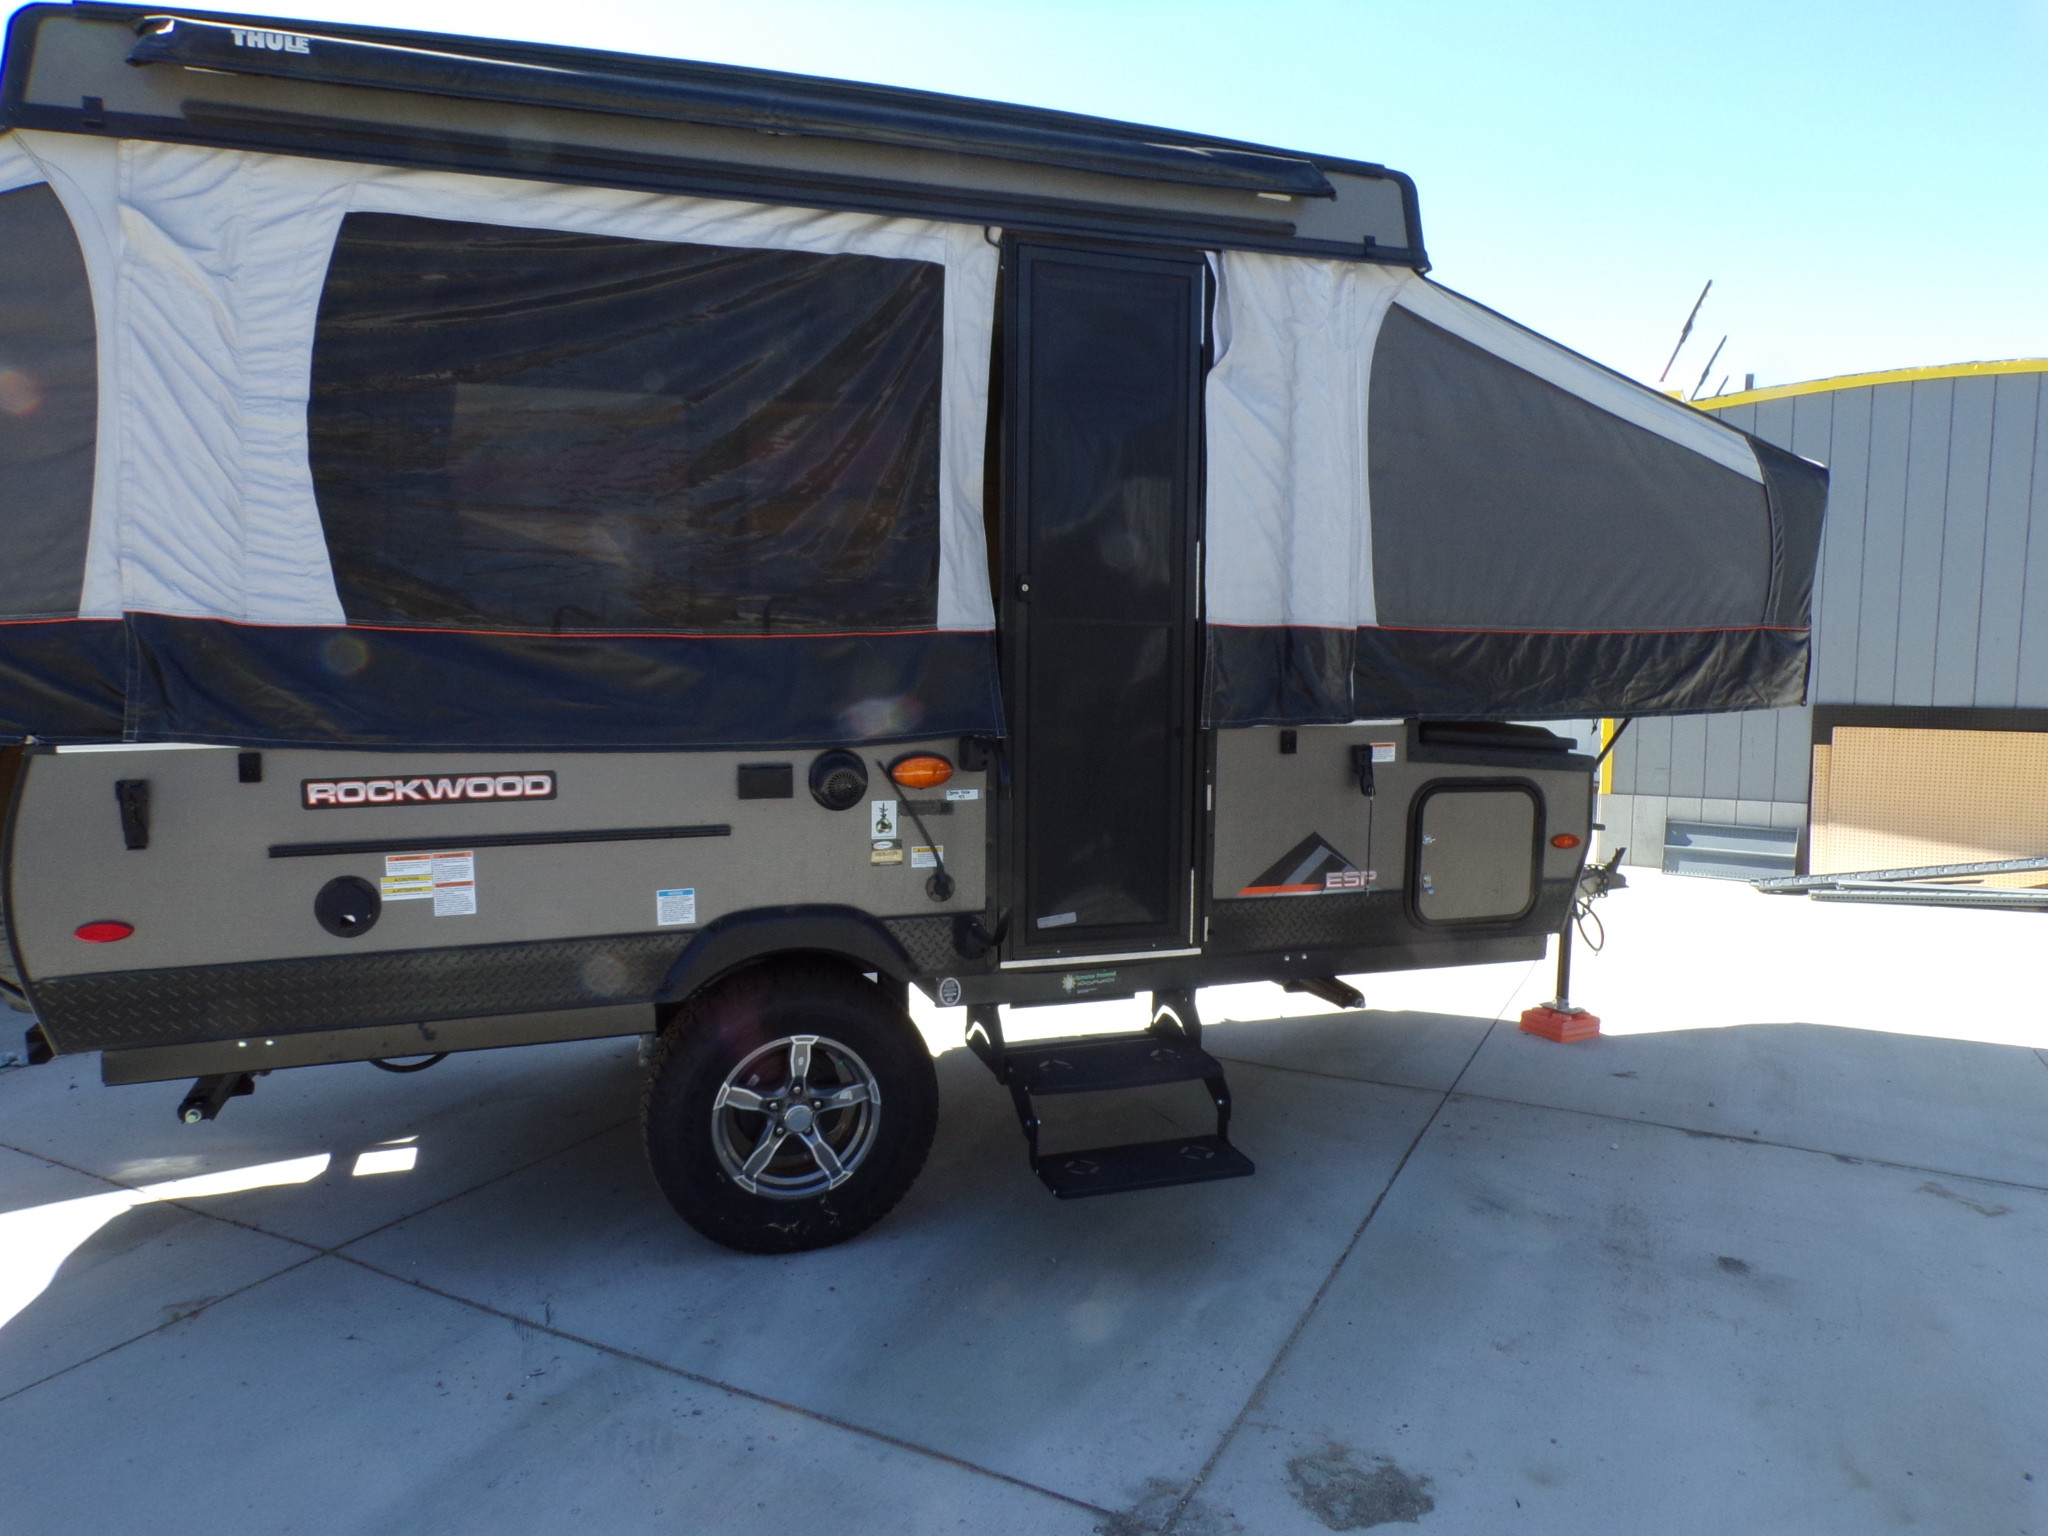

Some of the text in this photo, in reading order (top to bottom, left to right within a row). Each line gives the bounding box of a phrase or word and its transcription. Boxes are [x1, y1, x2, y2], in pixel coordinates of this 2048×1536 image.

[231, 29, 310, 54] THULE
[306, 775, 552, 805] ROCKWOOD
[1325, 870, 1377, 888] ESP
